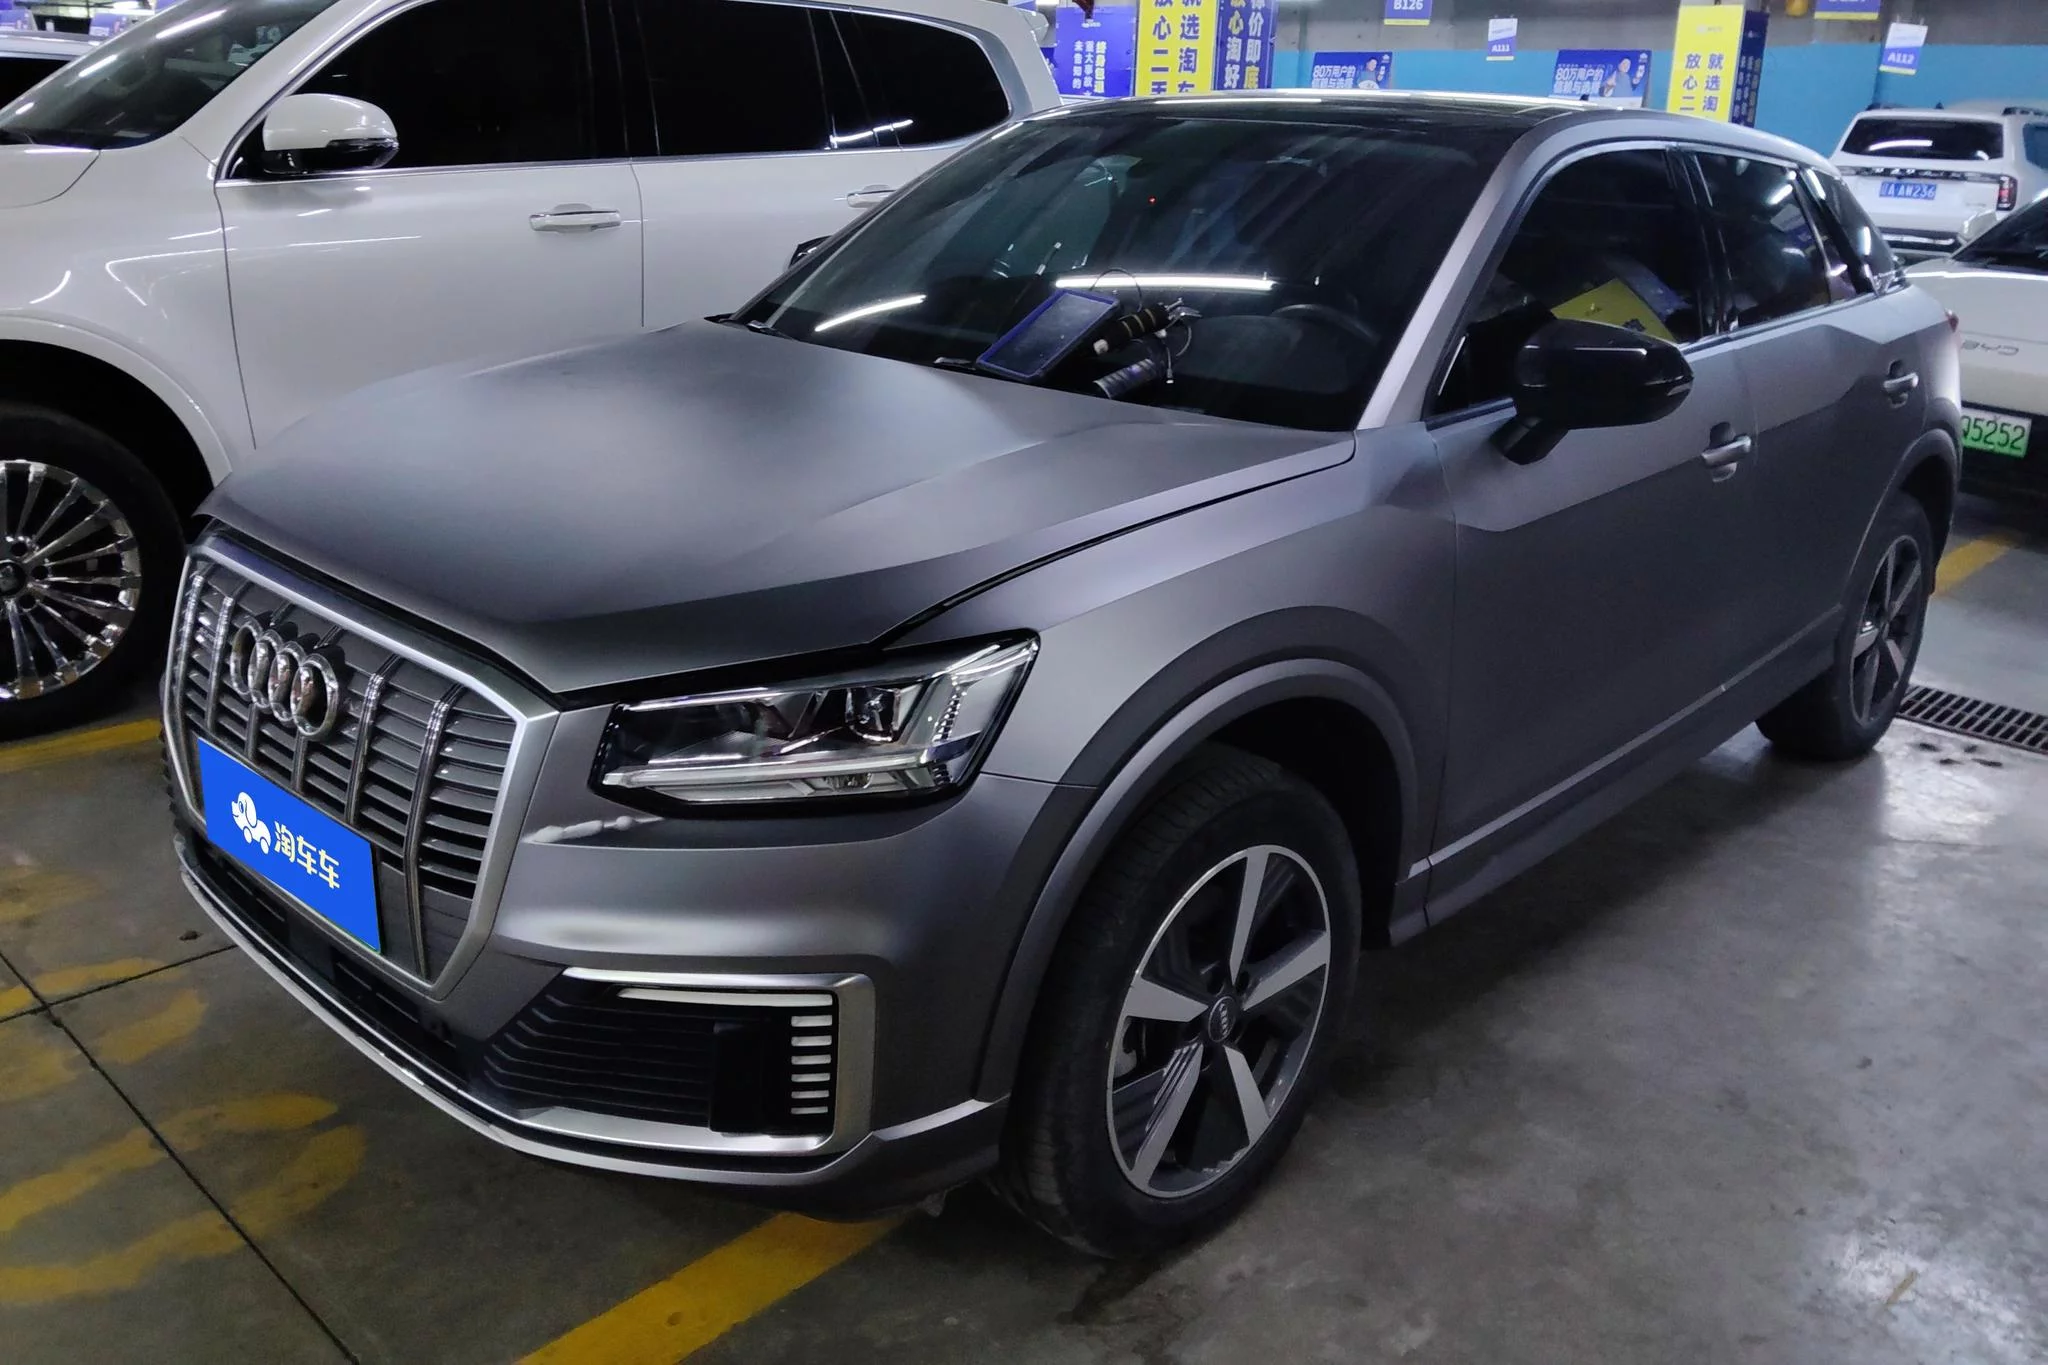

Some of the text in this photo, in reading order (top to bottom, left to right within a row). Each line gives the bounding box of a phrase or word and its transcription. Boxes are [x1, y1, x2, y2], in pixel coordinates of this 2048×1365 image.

[1151, 0, 1173, 95] 心二手
[1178, 0, 1201, 93] 选淘
